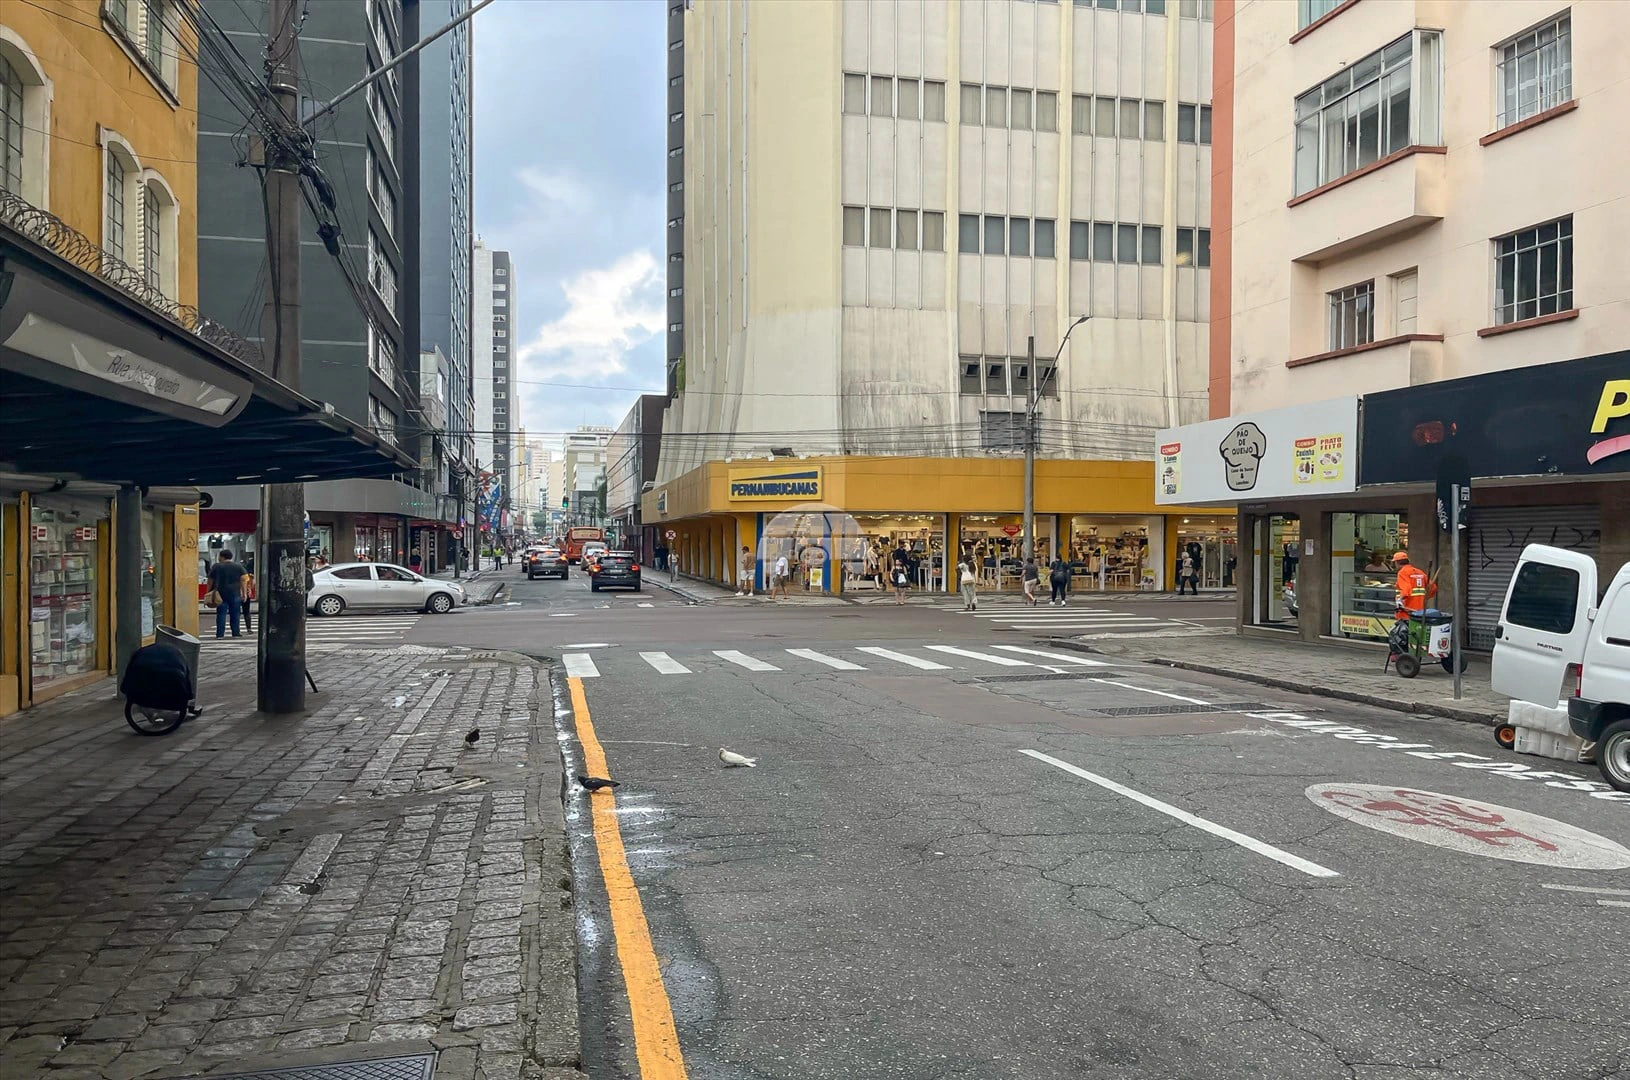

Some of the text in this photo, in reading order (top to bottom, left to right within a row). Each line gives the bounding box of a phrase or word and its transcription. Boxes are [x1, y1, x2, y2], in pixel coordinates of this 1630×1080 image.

[107, 355, 130, 376] Rua
[1236, 428, 1248, 438] PÃO
[1232, 446, 1253, 455] QUEIJO
[732, 482, 818, 496] PERNAMBUCANAS
[1404, 752, 1493, 760] E
[1450, 762, 1630, 807] DESC
